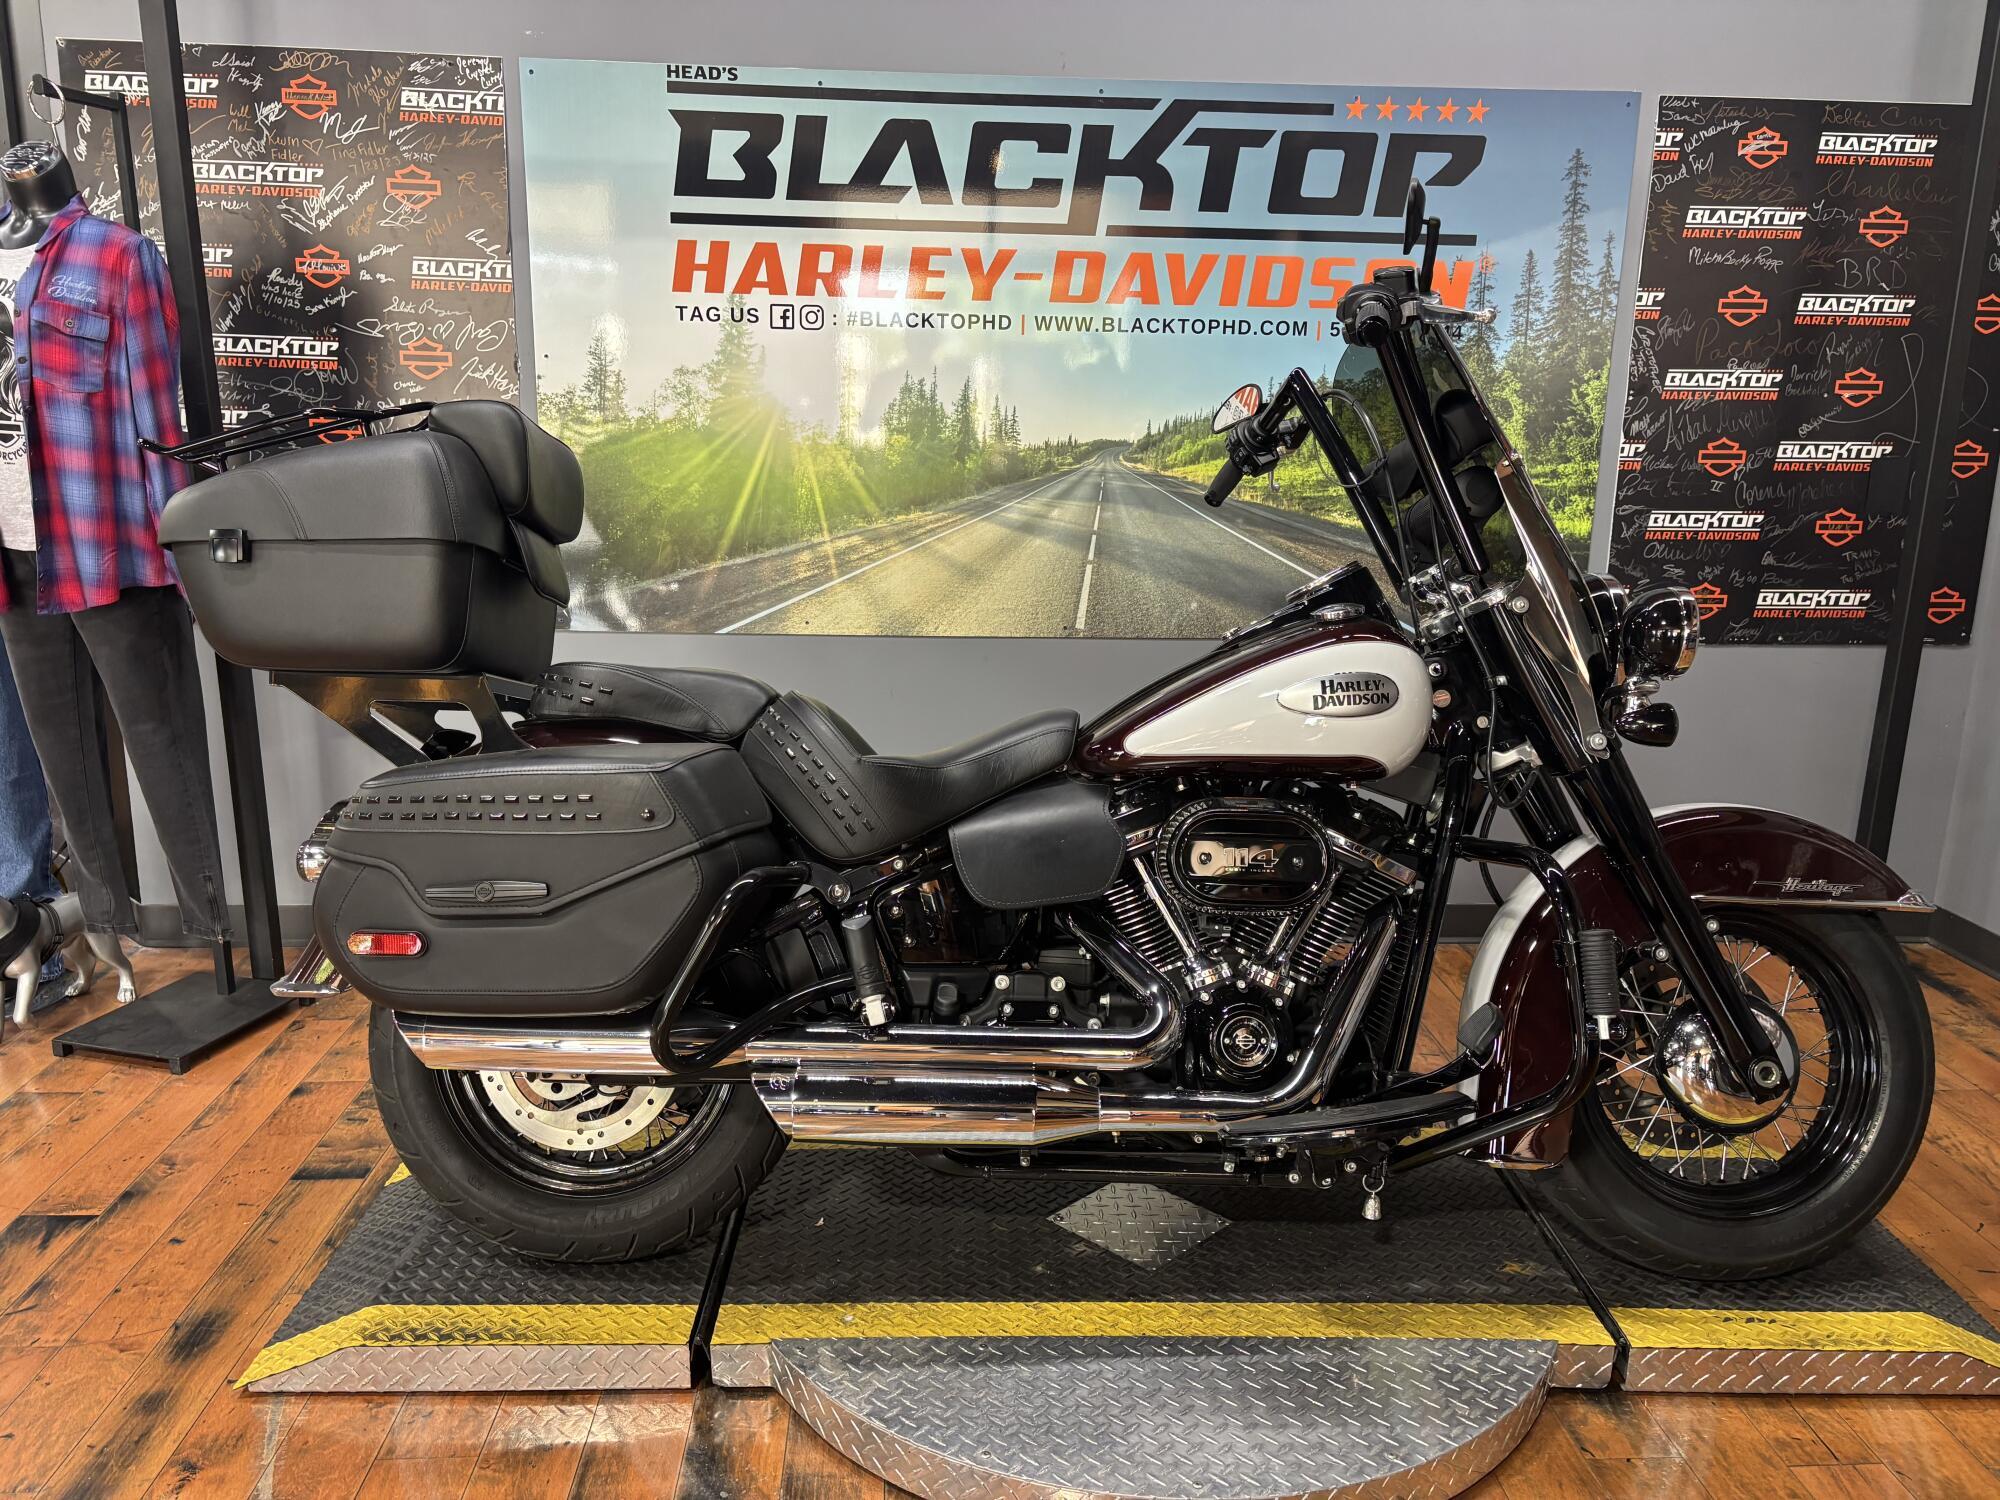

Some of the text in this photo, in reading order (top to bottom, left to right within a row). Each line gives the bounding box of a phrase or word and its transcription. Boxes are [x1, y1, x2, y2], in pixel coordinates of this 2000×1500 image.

[667, 64, 739, 81] HEAD'S
[400, 90, 504, 112] BLACKT
[1818, 133, 1938, 155] BLACKTOP
[668, 100, 1488, 234] BLACKTOP
[1815, 155, 1934, 167] HARLEY-DAVIDSON
[193, 162, 324, 183] BLACKTOP
[1685, 207, 1807, 229] BLACKTOP
[1682, 228, 1802, 240] HARLEY-DAVIDSON
[412, 260, 512, 280] BLACKT
[1797, 296, 1916, 315] BLACKTOP
[675, 305, 722, 322] TAG
[730, 307, 760, 323] US
[846, 310, 1013, 331] #BLACKTOPHD
[1034, 314, 1309, 337] WWW.BLACKTOPHD.COM
[1794, 315, 1911, 327] HARLEY-DAVIDSON
[215, 357, 338, 370] ARLEY-DAVIDSON
[1664, 371, 1784, 391] BLACKTOP
[1661, 390, 1778, 401] HARLEY-DAVIDSON
[1776, 443, 1893, 461] BLACKTOP
[1647, 511, 1765, 531] BLACKTOP
[1644, 531, 1760, 541] HARLEY-DAVIDSON
[1756, 591, 1872, 608] BLACKTOP
[1753, 609, 1866, 619] HARLEY-DAVIDSON
[1312, 692, 1390, 711] DAVIDSON
[1224, 847, 1279, 868] 114
[1781, 877, 1856, 897] Heritage
